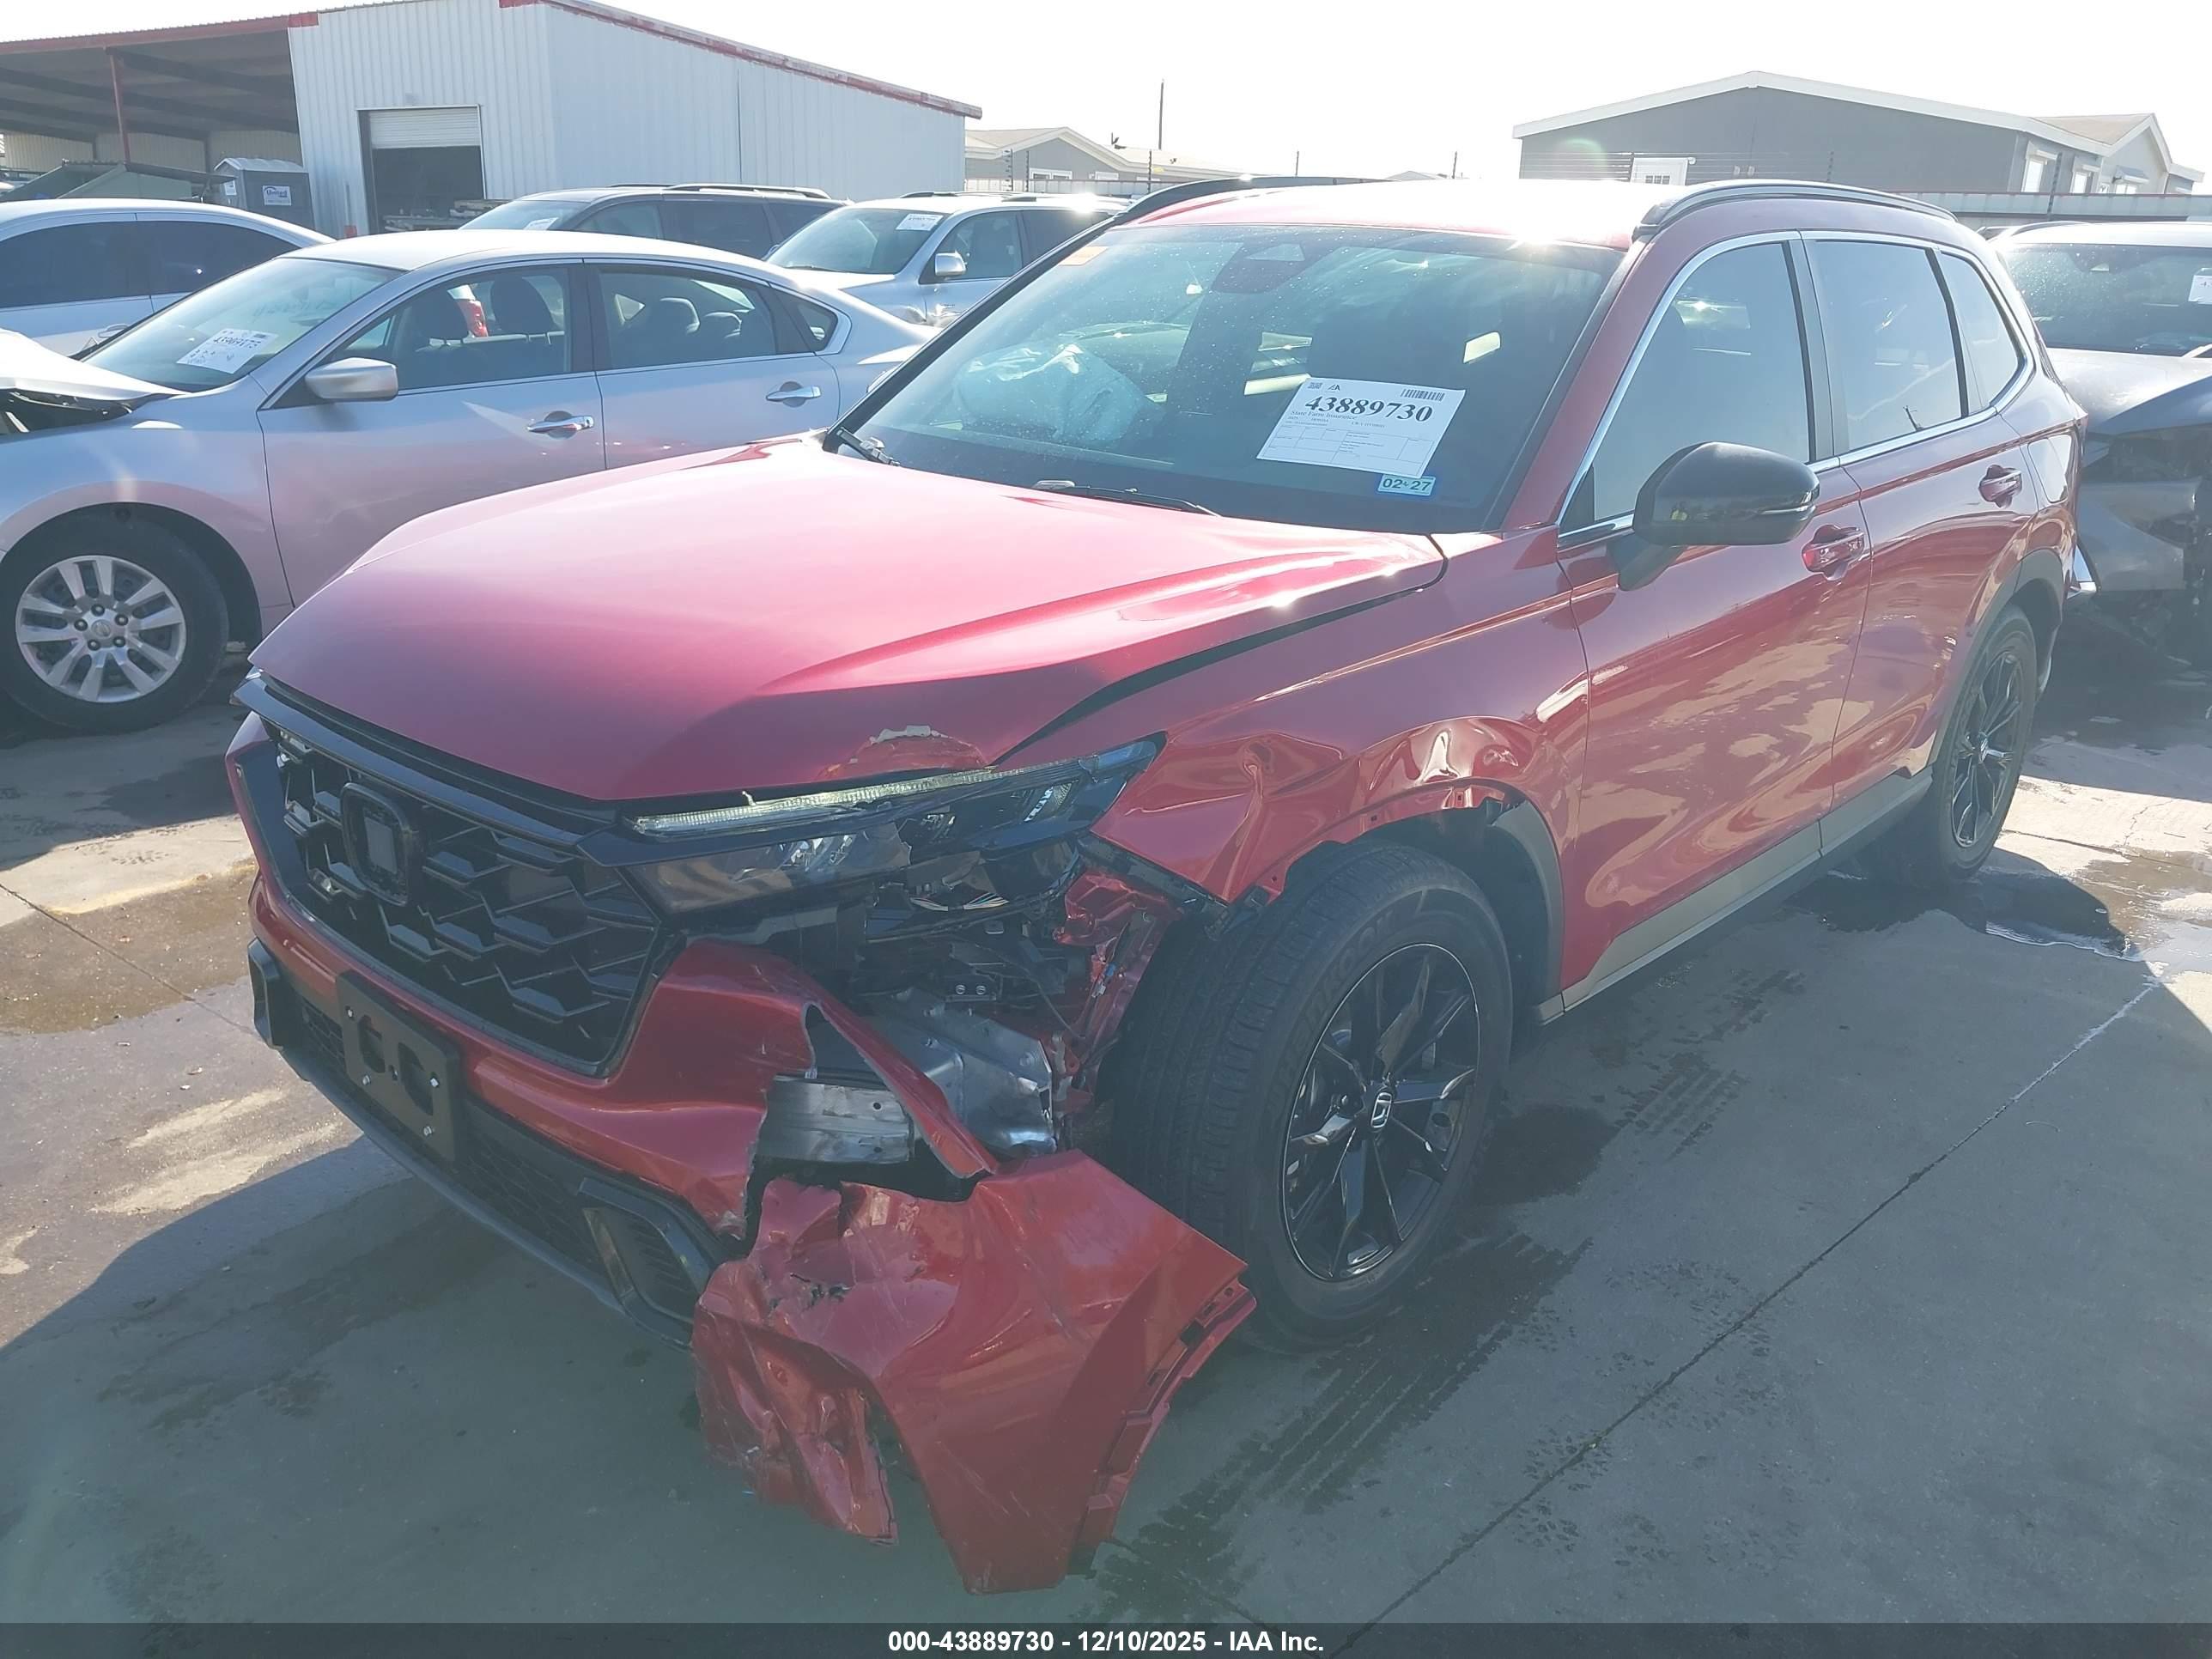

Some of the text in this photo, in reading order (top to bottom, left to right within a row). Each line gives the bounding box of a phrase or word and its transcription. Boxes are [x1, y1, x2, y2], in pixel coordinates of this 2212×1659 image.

[1304, 396, 1433, 422] 43889730
[1382, 478, 1431, 491] 02 27
